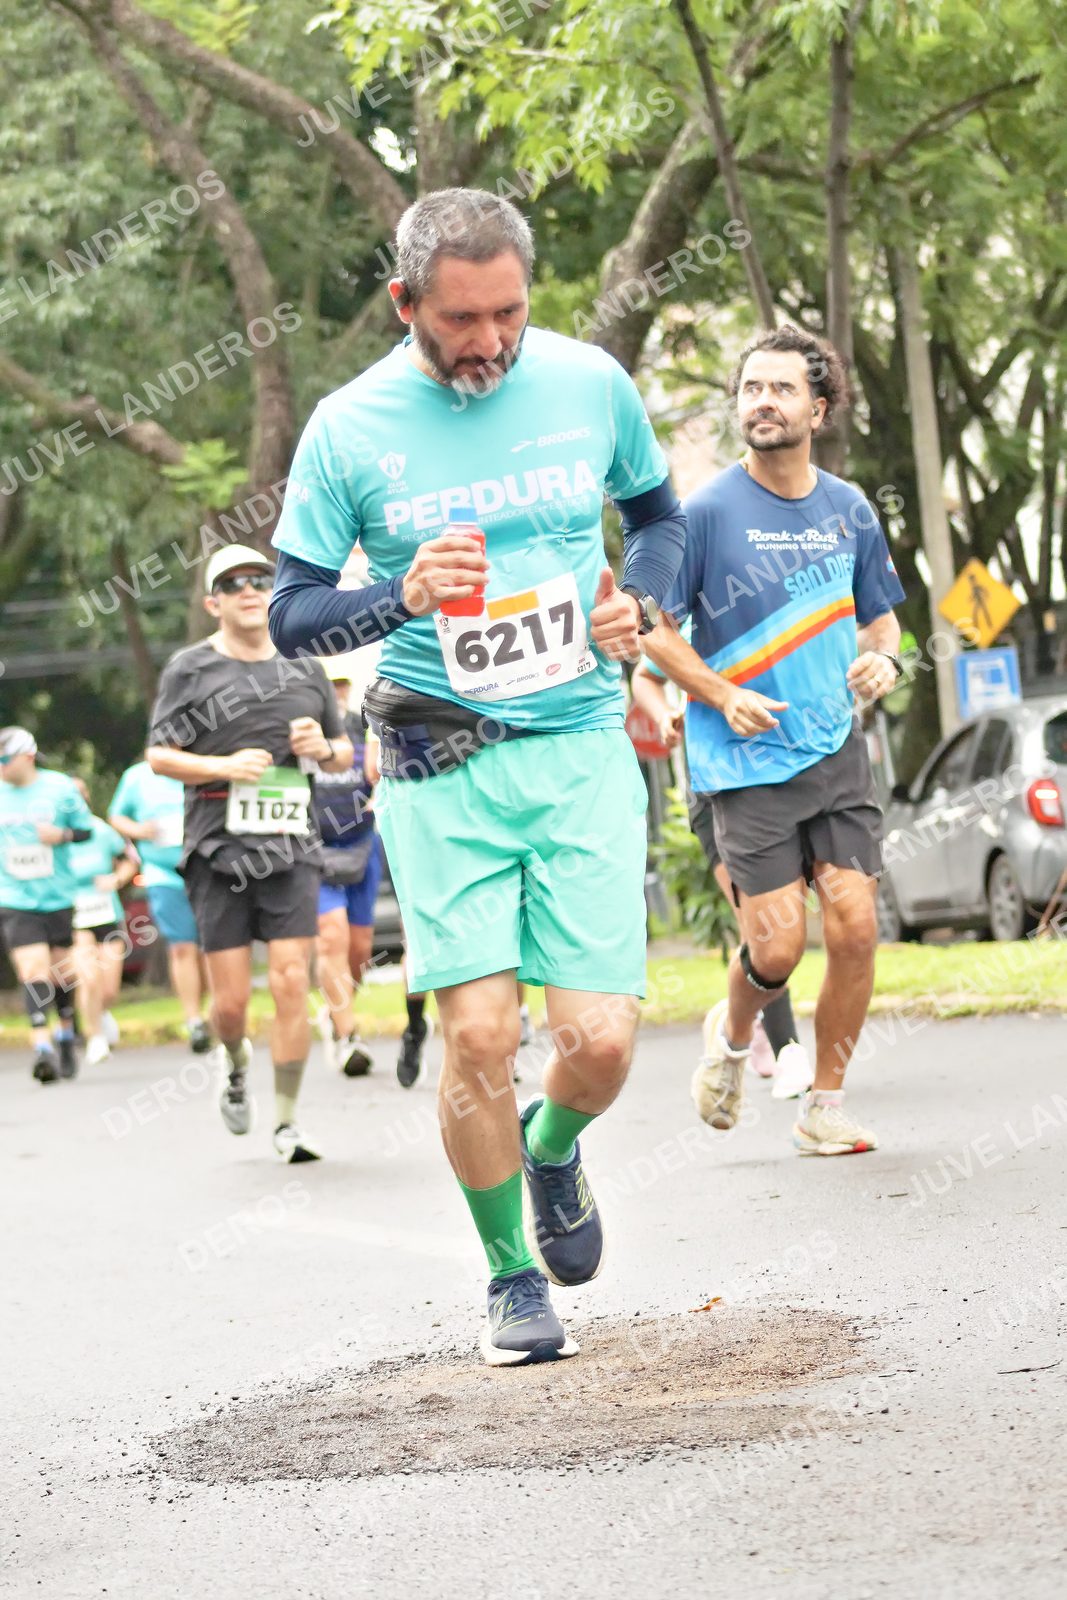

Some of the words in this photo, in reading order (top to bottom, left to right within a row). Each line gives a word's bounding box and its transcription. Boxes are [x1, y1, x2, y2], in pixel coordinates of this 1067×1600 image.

[537, 427, 591, 448] BROOKS
[383, 460, 598, 536] PERDURA
[746, 529, 793, 543] Rock
[801, 543, 834, 551] SERIES
[784, 564, 825, 601] SAN
[455, 600, 574, 673] 6217
[239, 800, 300, 820] 1102
